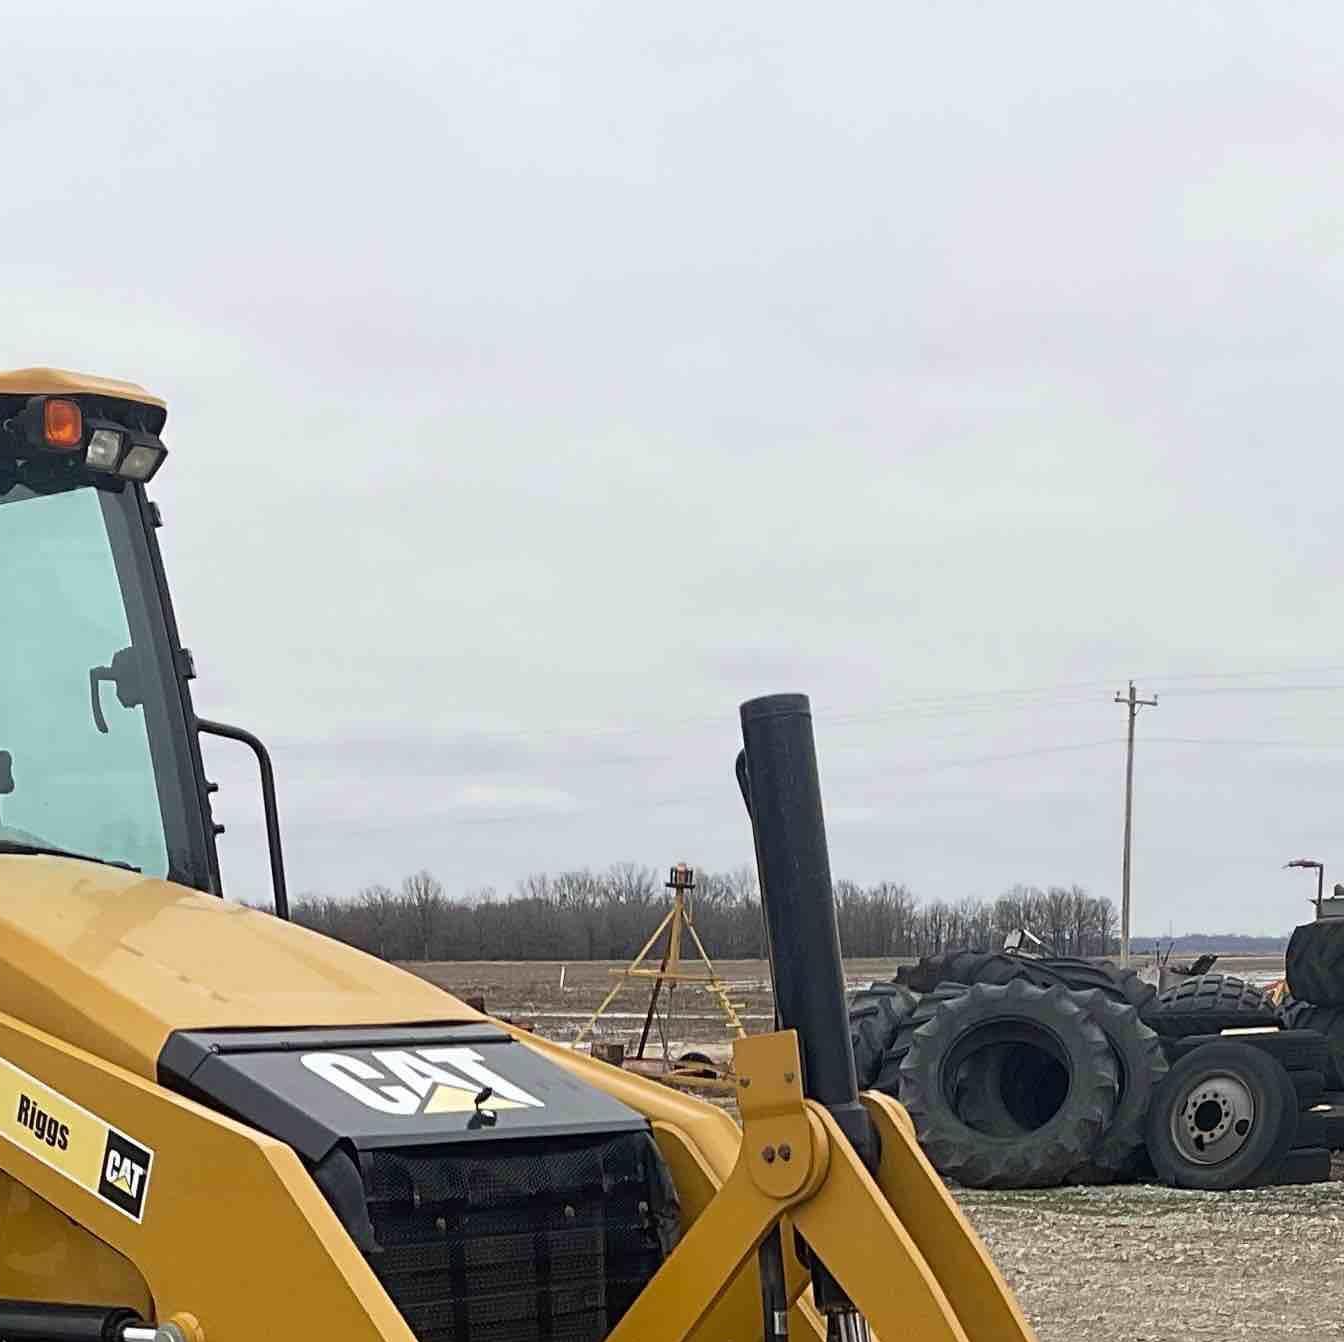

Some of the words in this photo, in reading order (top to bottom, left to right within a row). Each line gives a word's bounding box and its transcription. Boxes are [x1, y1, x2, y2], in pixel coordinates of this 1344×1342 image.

[299, 1047, 545, 1115] CAT
[17, 1093, 69, 1151] Riggs
[105, 1149, 145, 1198] CAT
